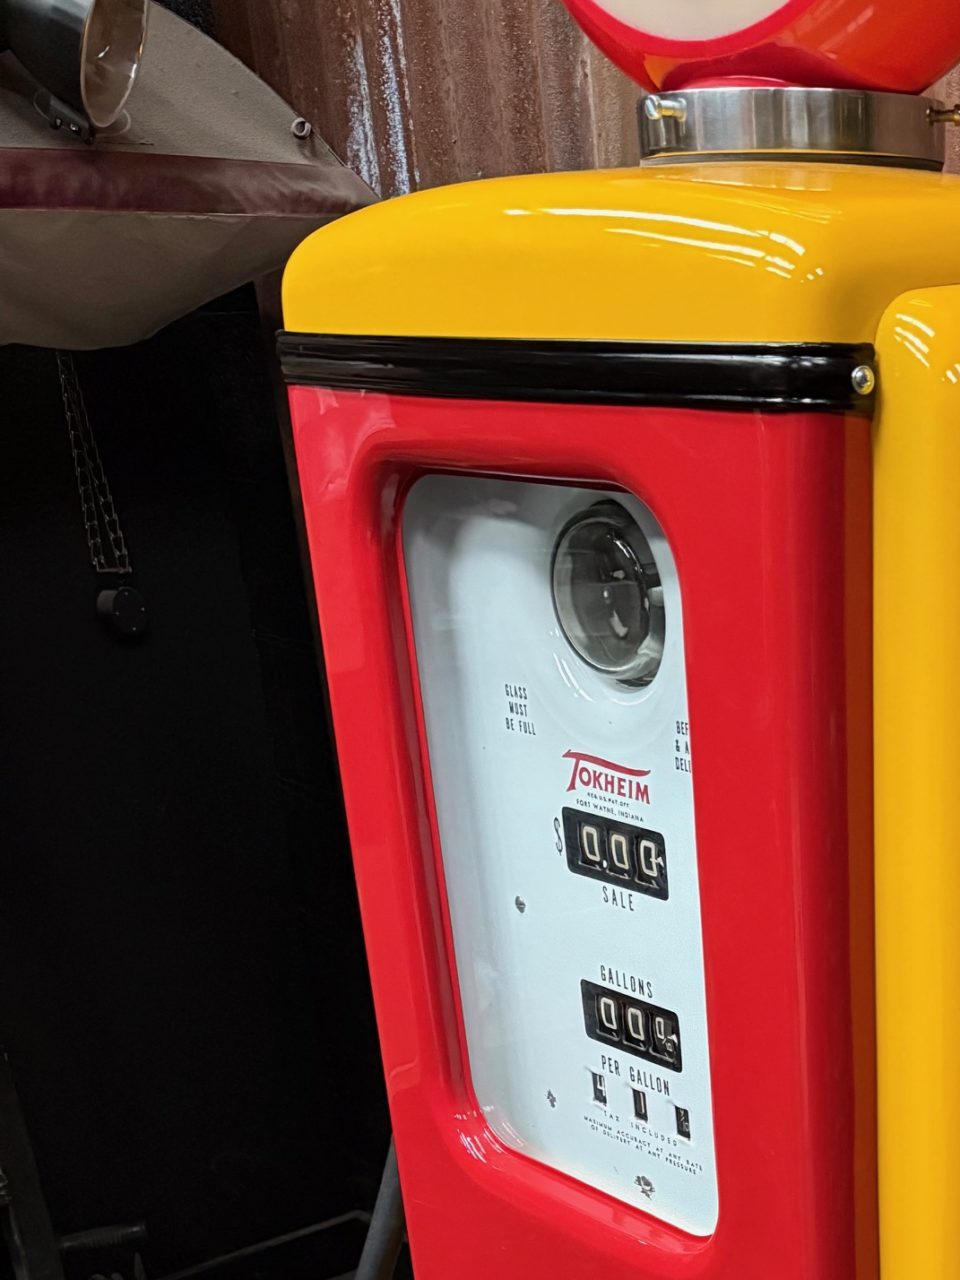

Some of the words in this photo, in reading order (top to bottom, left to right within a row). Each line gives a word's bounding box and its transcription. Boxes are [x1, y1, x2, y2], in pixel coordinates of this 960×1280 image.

[505, 684, 528, 700] GLASS
[509, 701, 528, 717] MUST
[505, 717, 515, 731] BE
[519, 720, 536, 736] FULL
[676, 721, 688, 736] BEF
[562, 749, 651, 805] TOKHEIM
[554, 816, 563, 856] $
[602, 885, 634, 911] SALE
[600, 964, 653, 999] GALLONS
[601, 1055, 620, 1076] PER
[629, 1066, 670, 1096] GALLON
[603, 1110, 620, 1122] TAX
[630, 1121, 677, 1147] INCLUDED
